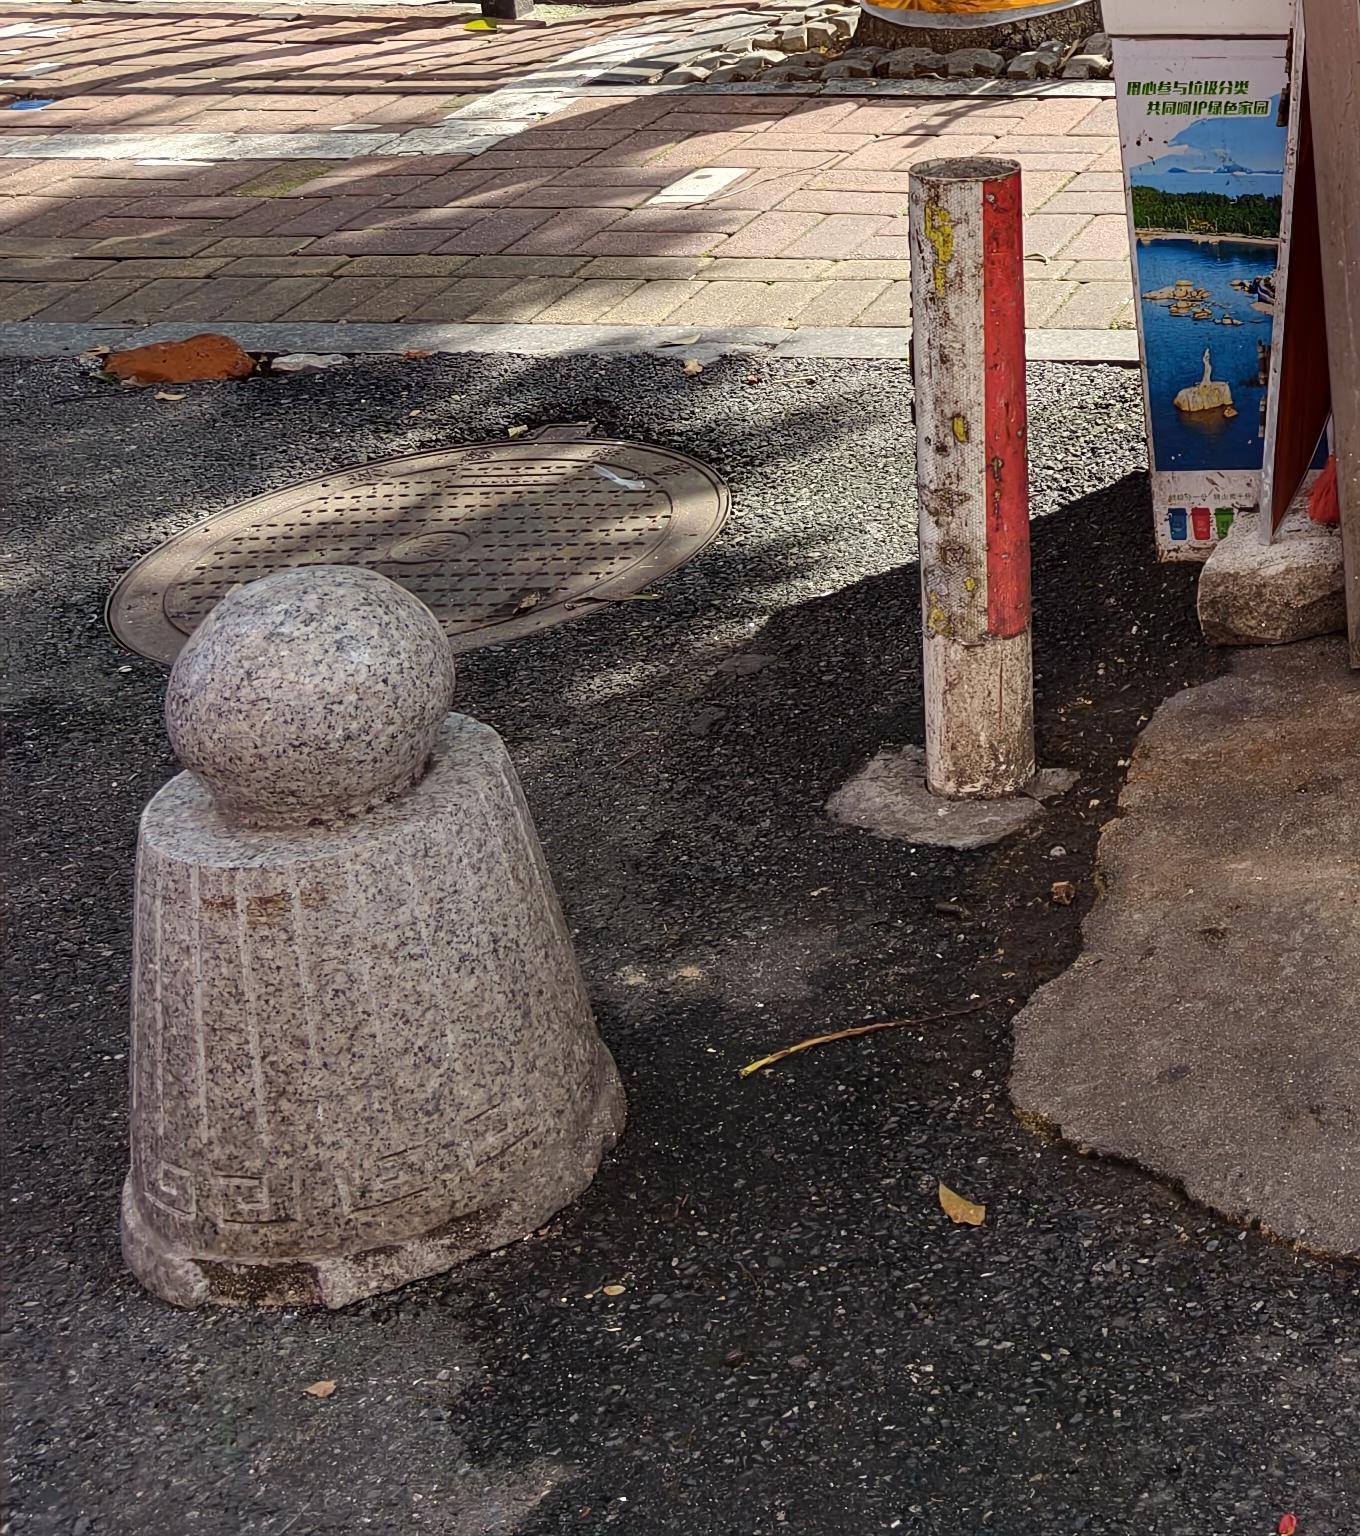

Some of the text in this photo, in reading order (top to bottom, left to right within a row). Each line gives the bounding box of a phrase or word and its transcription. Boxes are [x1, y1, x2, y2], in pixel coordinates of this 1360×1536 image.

[1126, 80, 1250, 98] 用心参与垃圾分类
[1146, 99, 1270, 117] 共同呵护绿色家园
